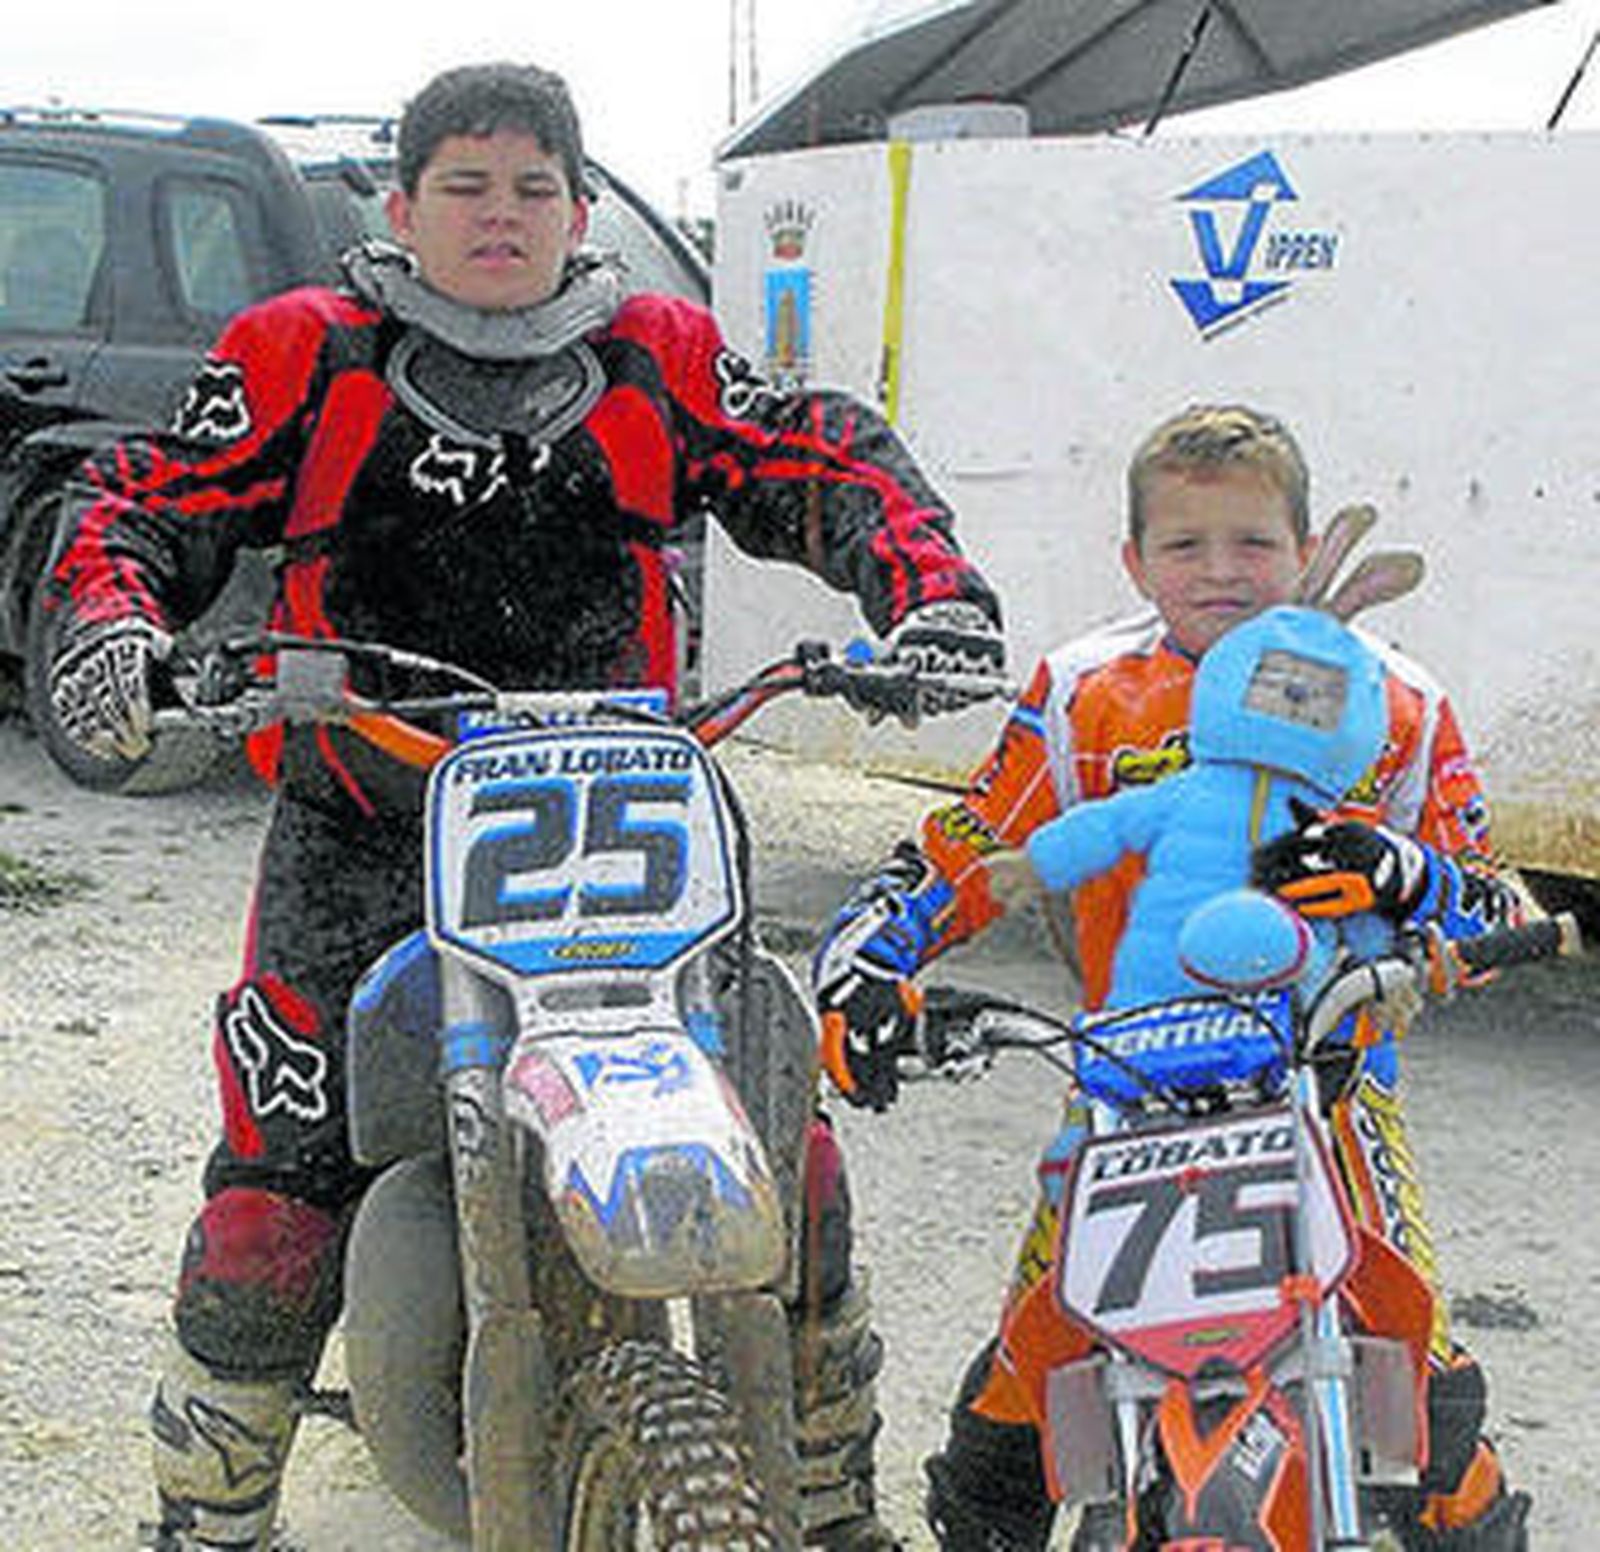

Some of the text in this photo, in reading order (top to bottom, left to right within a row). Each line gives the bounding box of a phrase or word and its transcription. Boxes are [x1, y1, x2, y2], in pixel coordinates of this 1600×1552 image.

[454, 747, 692, 784] FRAN LOBATO
[459, 771, 693, 929] 25
[1093, 1125, 1294, 1182] LOBATO
[1085, 1158, 1299, 1315] 75
